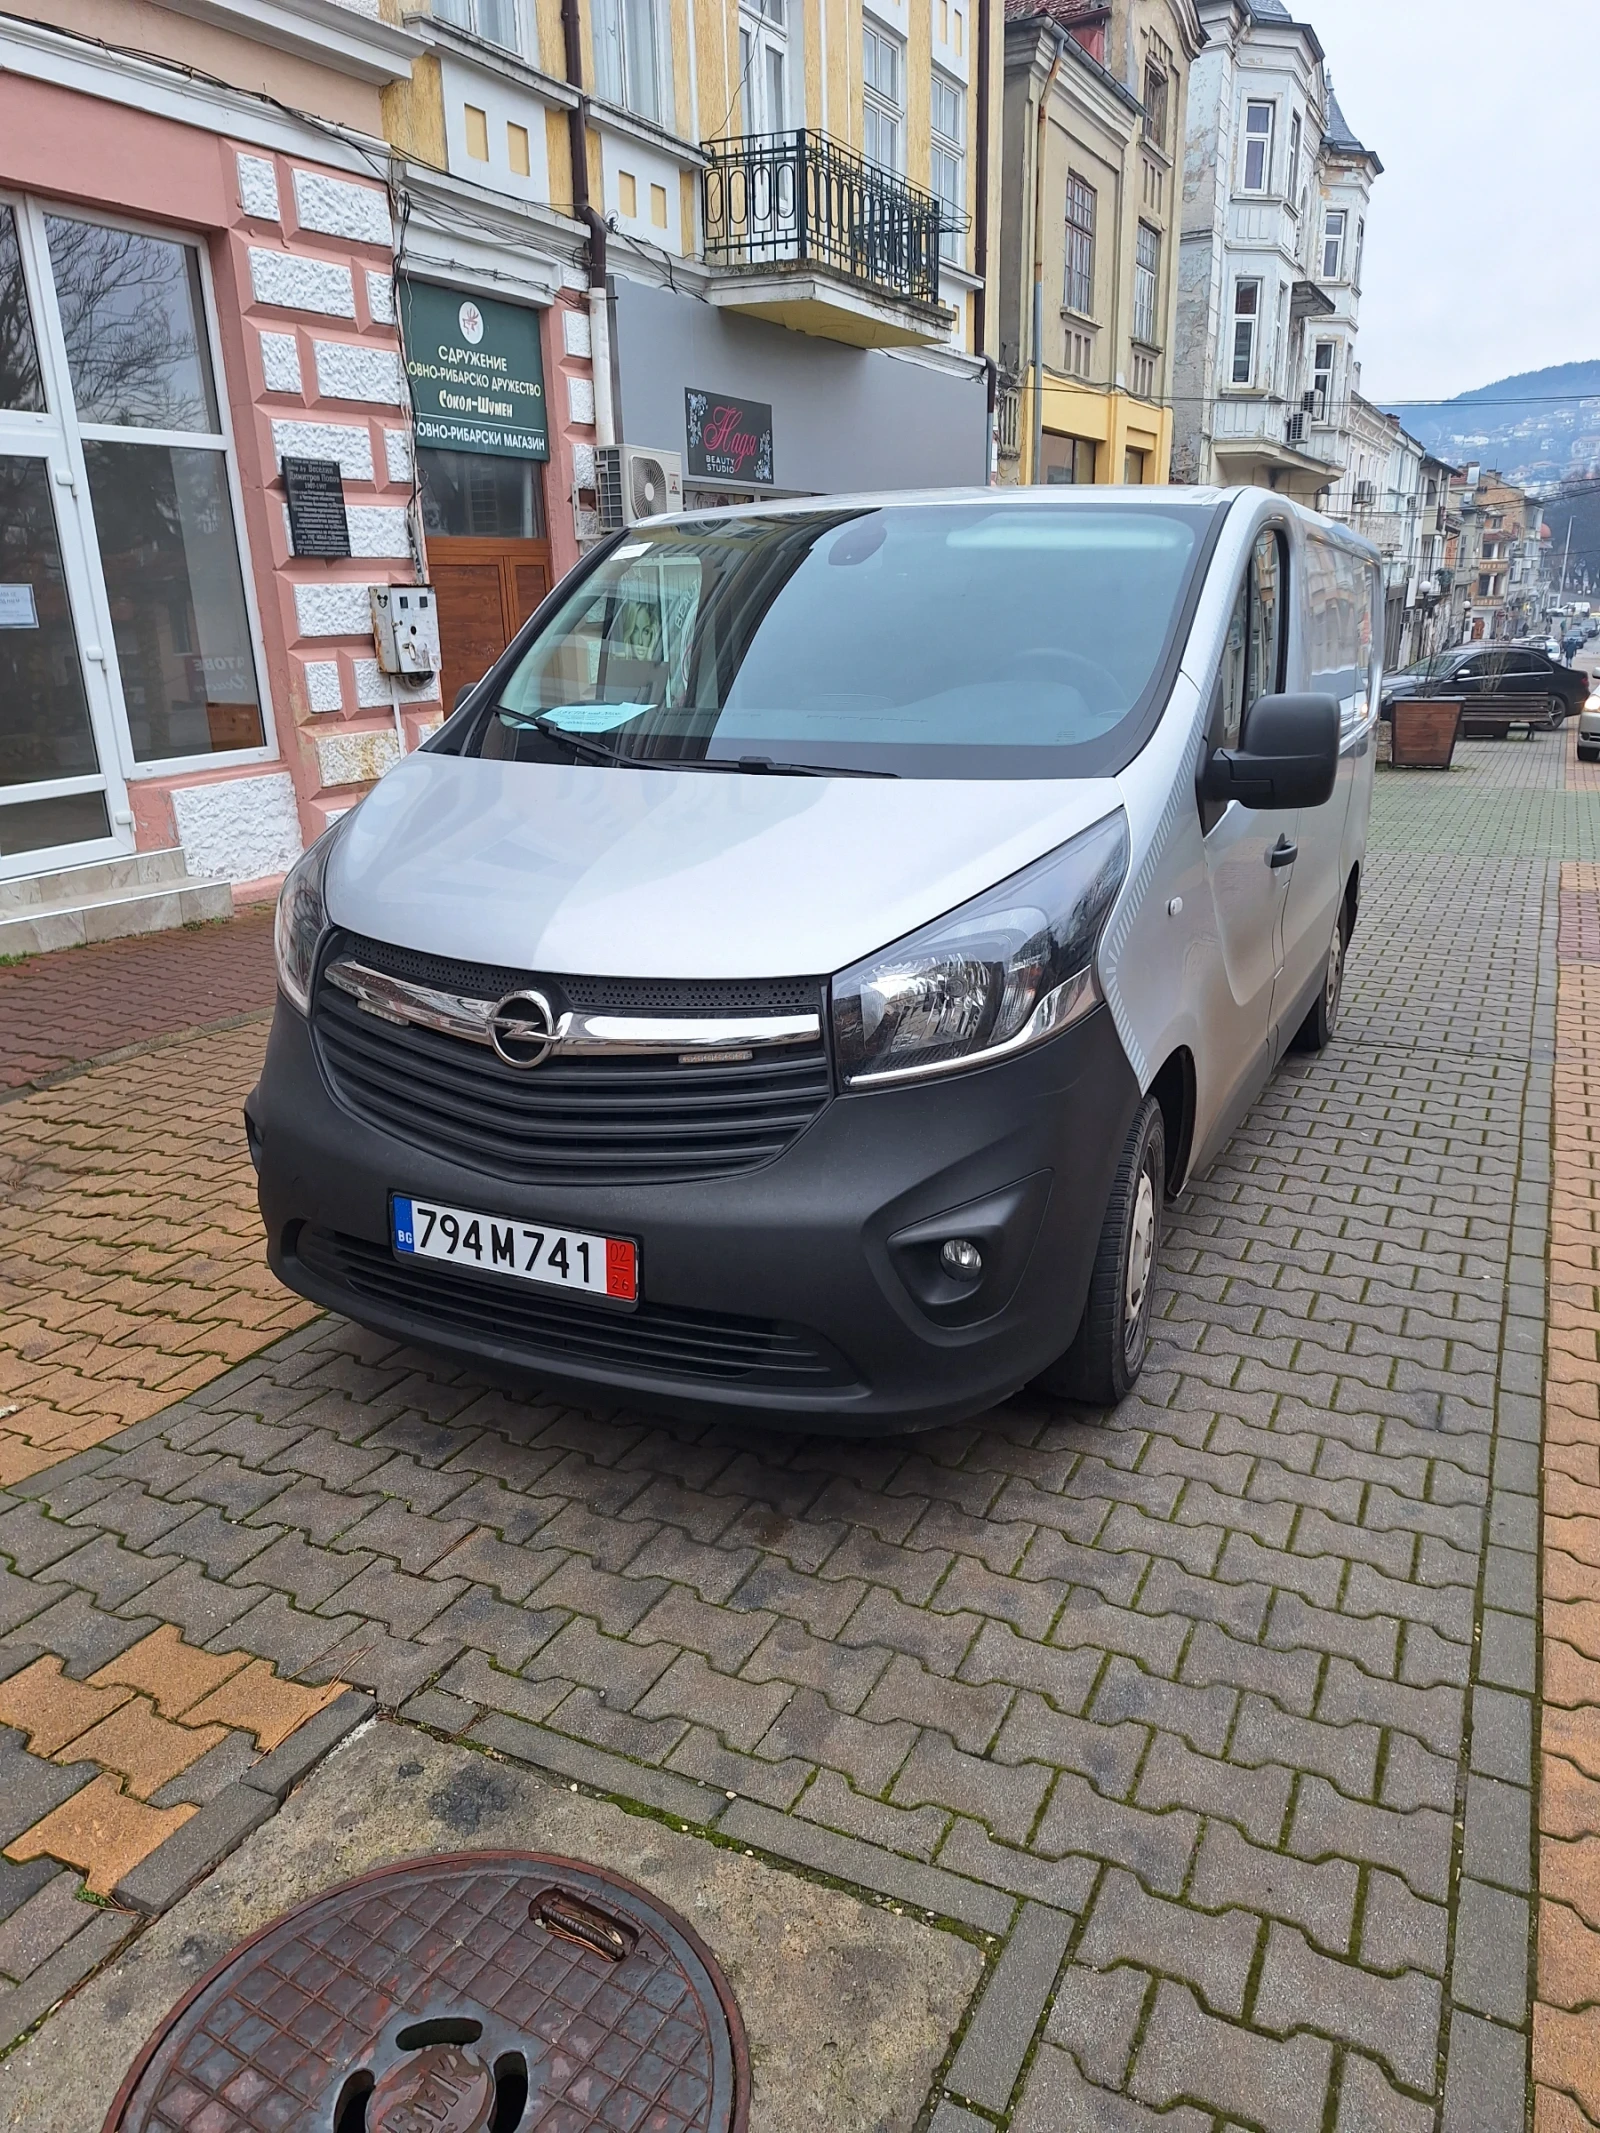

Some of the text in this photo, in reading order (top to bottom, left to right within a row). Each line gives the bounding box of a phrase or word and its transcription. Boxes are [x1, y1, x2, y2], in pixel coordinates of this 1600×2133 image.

[438, 345, 507, 372] СДРУЖЕНИЕ
[406, 361, 541, 397] ОВНО-РИБАРСКО ДРУЖЕСТВО
[503, 433, 545, 451] МАГАЗИН
[705, 454, 735, 466] BEAUTY
[706, 463, 735, 474] STUDIO
[397, 1229, 413, 1244] BG
[417, 1208, 590, 1284] 794M741
[610, 1242, 631, 1263] 02
[611, 1274, 629, 1291] 26
